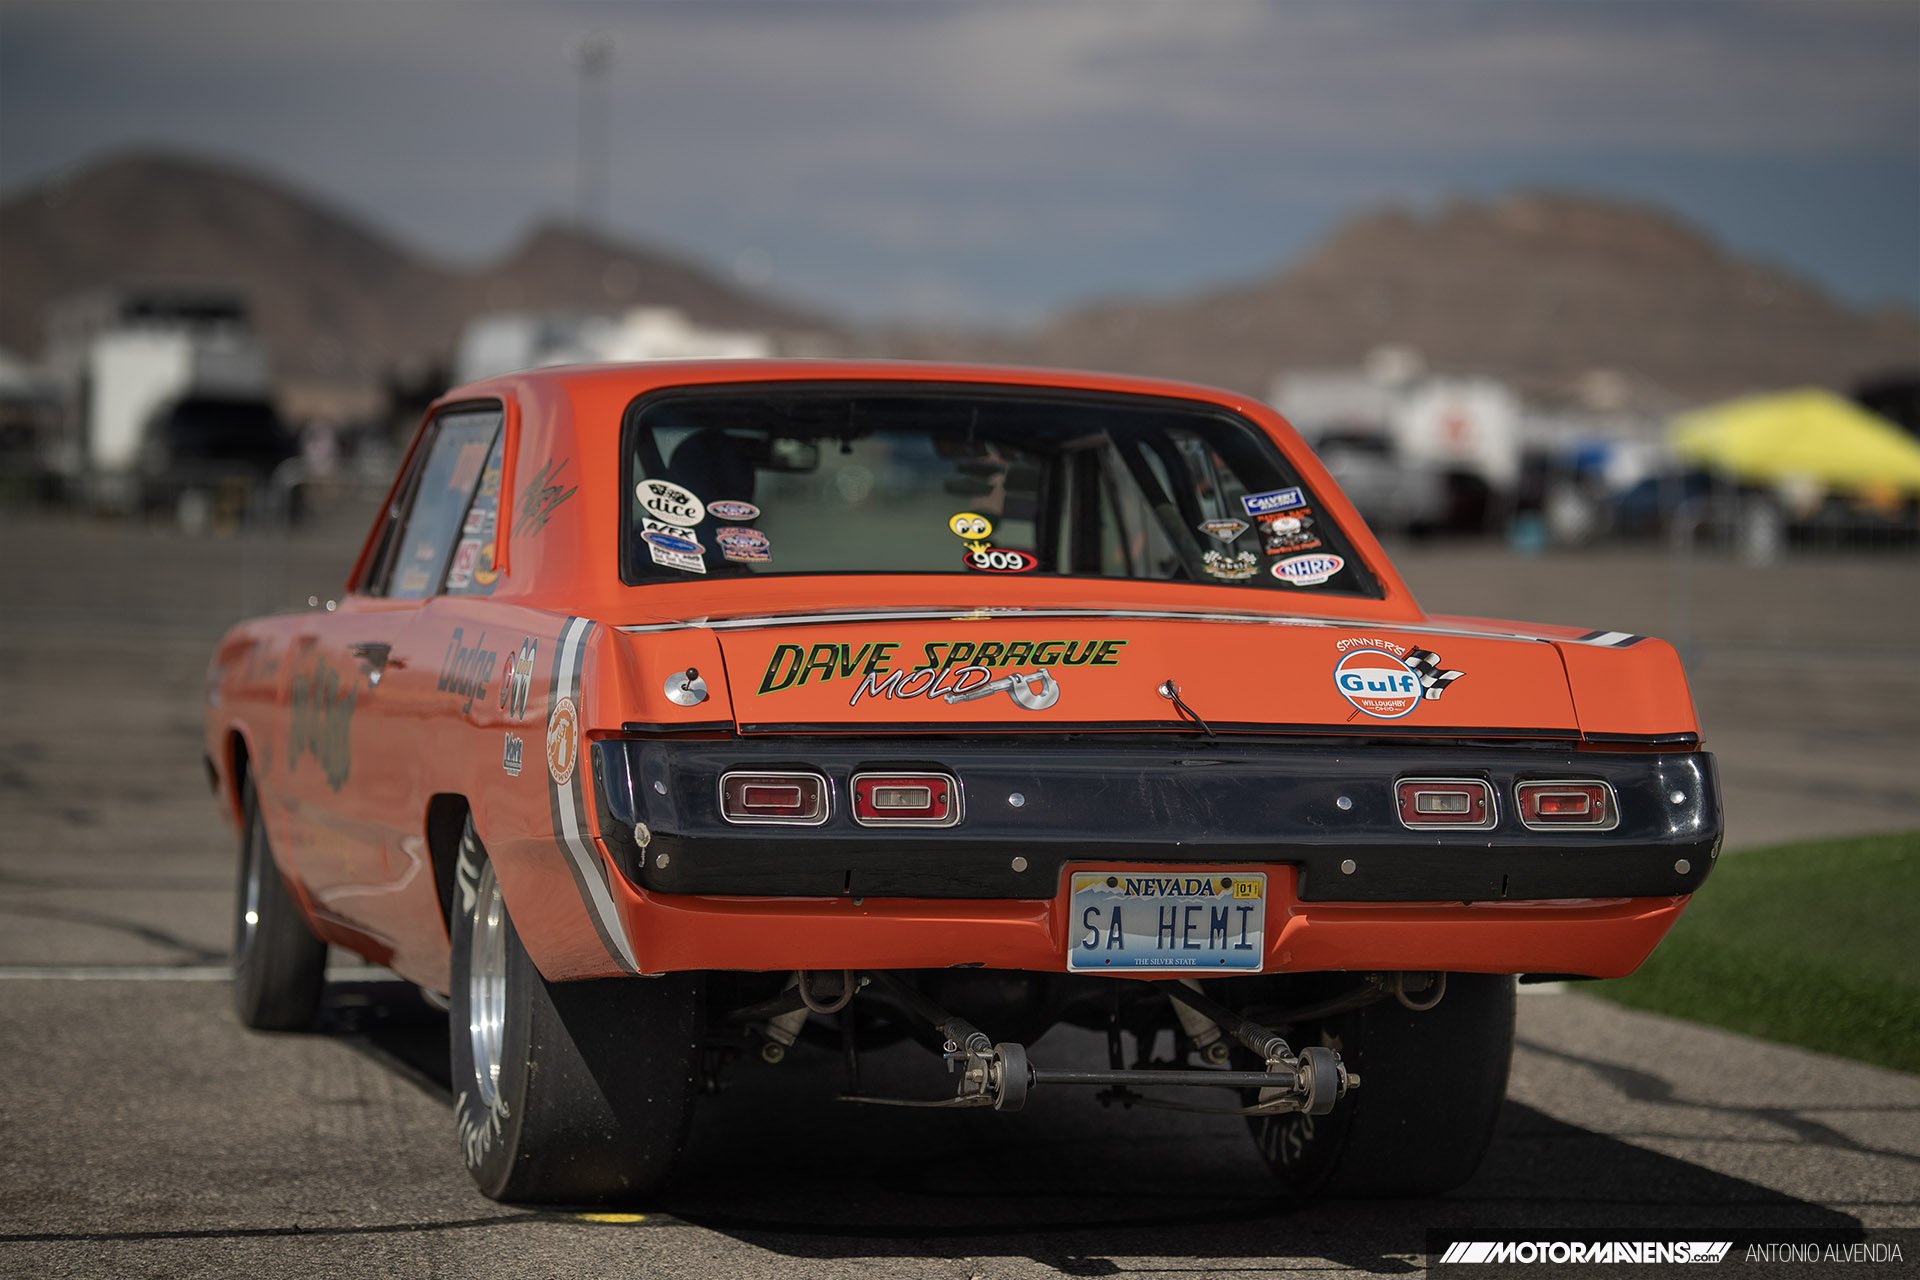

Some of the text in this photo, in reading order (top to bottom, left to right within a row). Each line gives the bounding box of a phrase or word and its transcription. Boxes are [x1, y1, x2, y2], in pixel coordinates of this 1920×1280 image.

[647, 498, 696, 518] dice
[1247, 491, 1297, 508] CALVERT
[973, 551, 1023, 570] 909
[1284, 559, 1335, 576] NHRA
[1336, 637, 1406, 656] SPINNER'S
[437, 627, 497, 714] Dodge
[756, 640, 1130, 696] DAVE SPRAGUE
[849, 665, 992, 707] MOLD
[1340, 674, 1414, 692] Gulf
[1361, 699, 1406, 707] WILLOUGHBY
[1124, 878, 1216, 896] NEVADA
[1240, 883, 1252, 893] 01
[1082, 906, 1254, 950] SA HEMI
